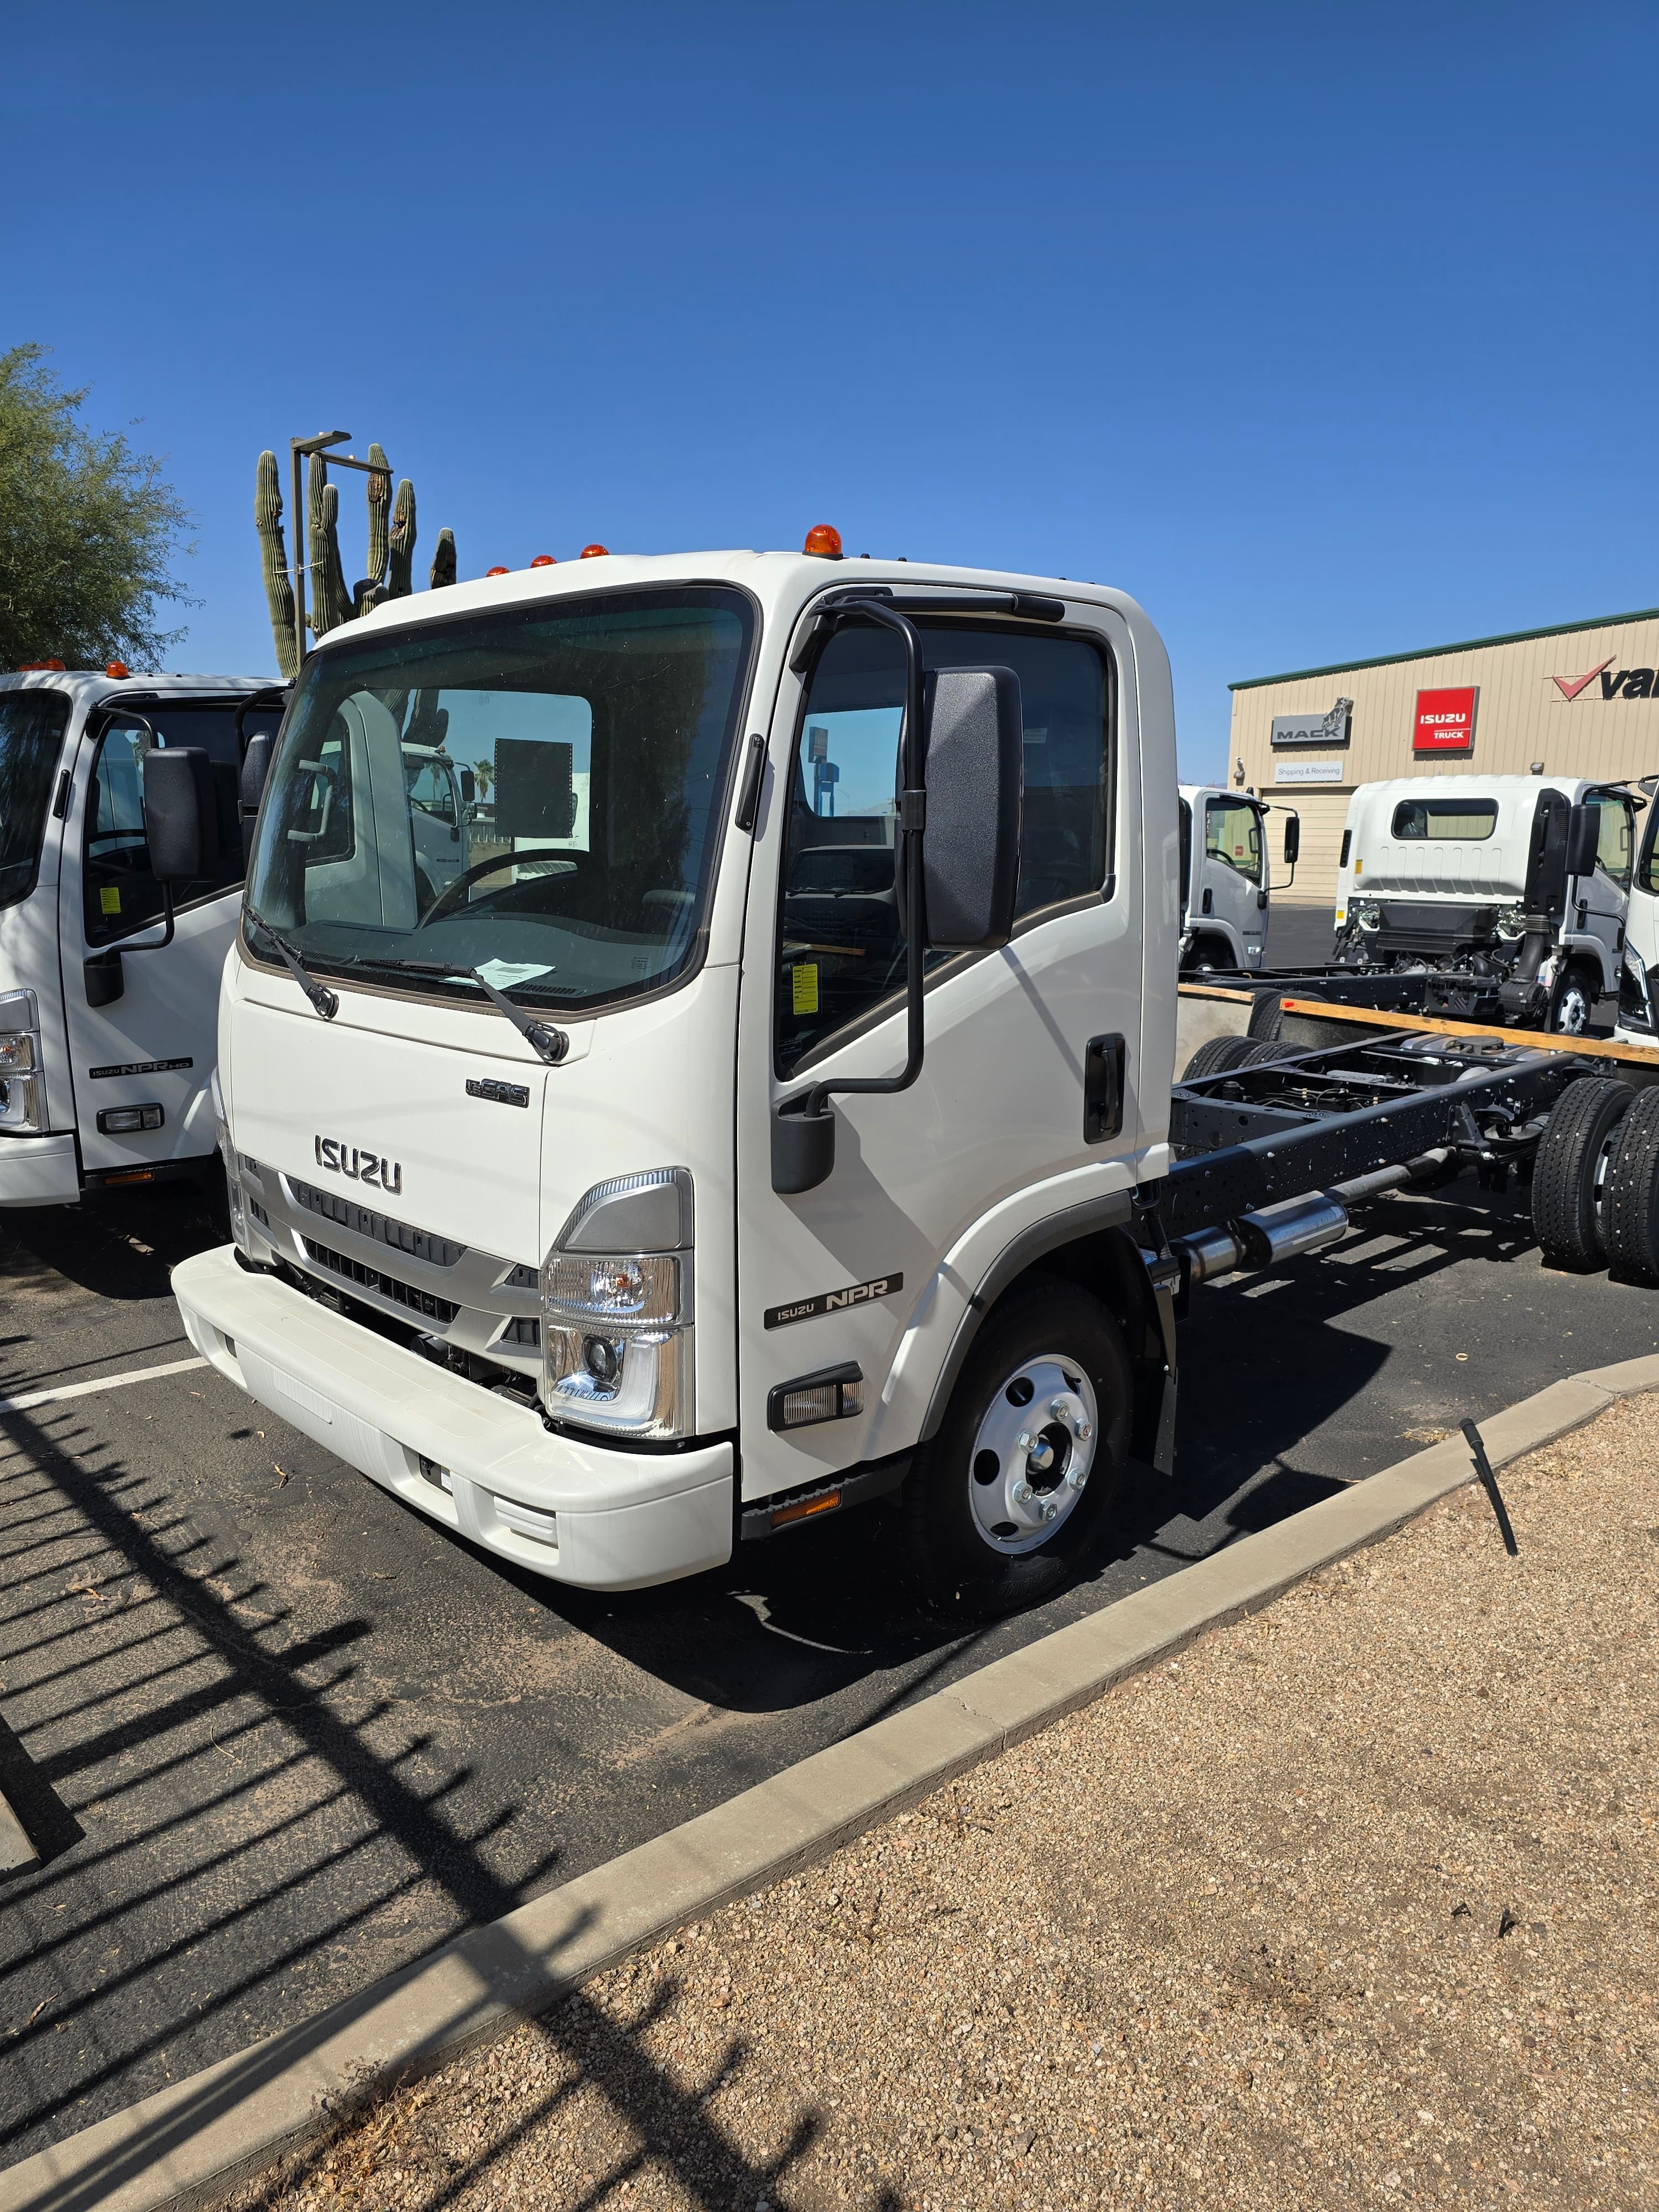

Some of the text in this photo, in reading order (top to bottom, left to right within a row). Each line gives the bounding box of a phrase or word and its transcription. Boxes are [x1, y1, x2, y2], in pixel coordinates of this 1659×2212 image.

[1600, 667, 1659, 700] va
[1420, 713, 1465, 724] ISUZU
[1277, 727, 1340, 739] MACK
[1278, 768, 1304, 776] Shipping
[1311, 767, 1340, 775] Receiving
[121, 1061, 168, 1074] NPR
[314, 1134, 403, 1196] ISUZU
[778, 1279, 888, 1321] ISUZU NPR
